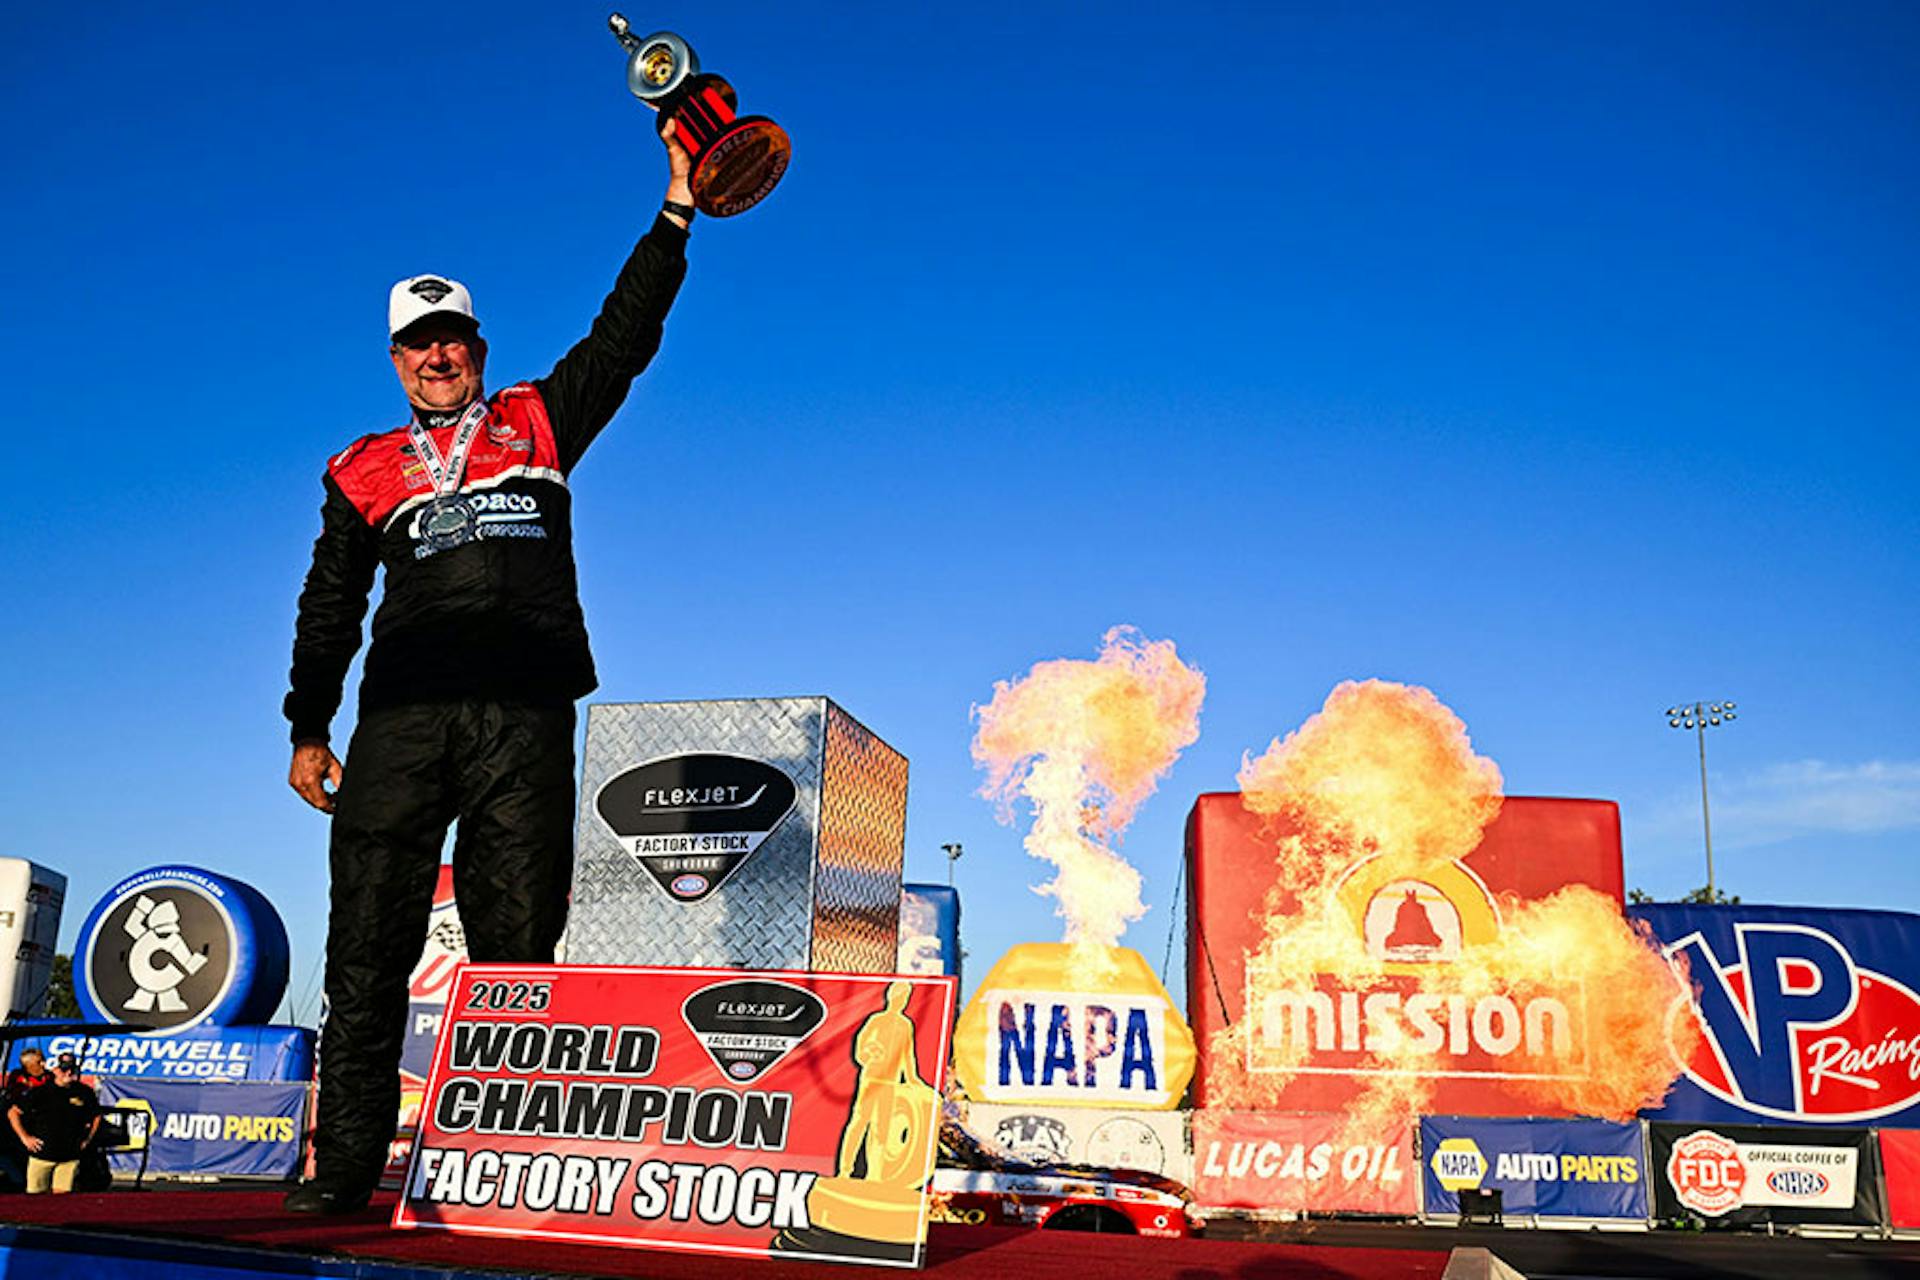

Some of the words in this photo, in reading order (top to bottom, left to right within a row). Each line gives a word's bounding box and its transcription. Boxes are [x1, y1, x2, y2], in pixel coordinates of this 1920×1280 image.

[635, 837, 698, 853] FACTORY
[701, 834, 750, 851] STOCK
[467, 981, 550, 1011] 2025
[1662, 922, 1856, 1114] VP
[49, 1036, 247, 1061] CORNWELL
[450, 1022, 661, 1077] WORLD
[998, 1001, 1157, 1092] NAPA
[161, 1060, 248, 1077] TOOLS
[163, 1112, 221, 1141] AUTO
[223, 1114, 295, 1143] PARTS
[434, 1078, 794, 1151] CHAMPION
[1203, 1141, 1335, 1181] LUCAS
[1339, 1143, 1404, 1183] OIL
[1441, 1153, 1480, 1177] NAPA
[1495, 1153, 1559, 1181] AUTO
[1561, 1155, 1640, 1184] PARTS
[1680, 1158, 1742, 1189] FDC
[1748, 1151, 1793, 1164] OFFICIAL
[1795, 1152, 1832, 1165] COFFEE
[1834, 1153, 1848, 1165] OF
[411, 1148, 630, 1215] FACTORY
[634, 1162, 819, 1229] STOCK
[1773, 1170, 1825, 1195] NHRA
